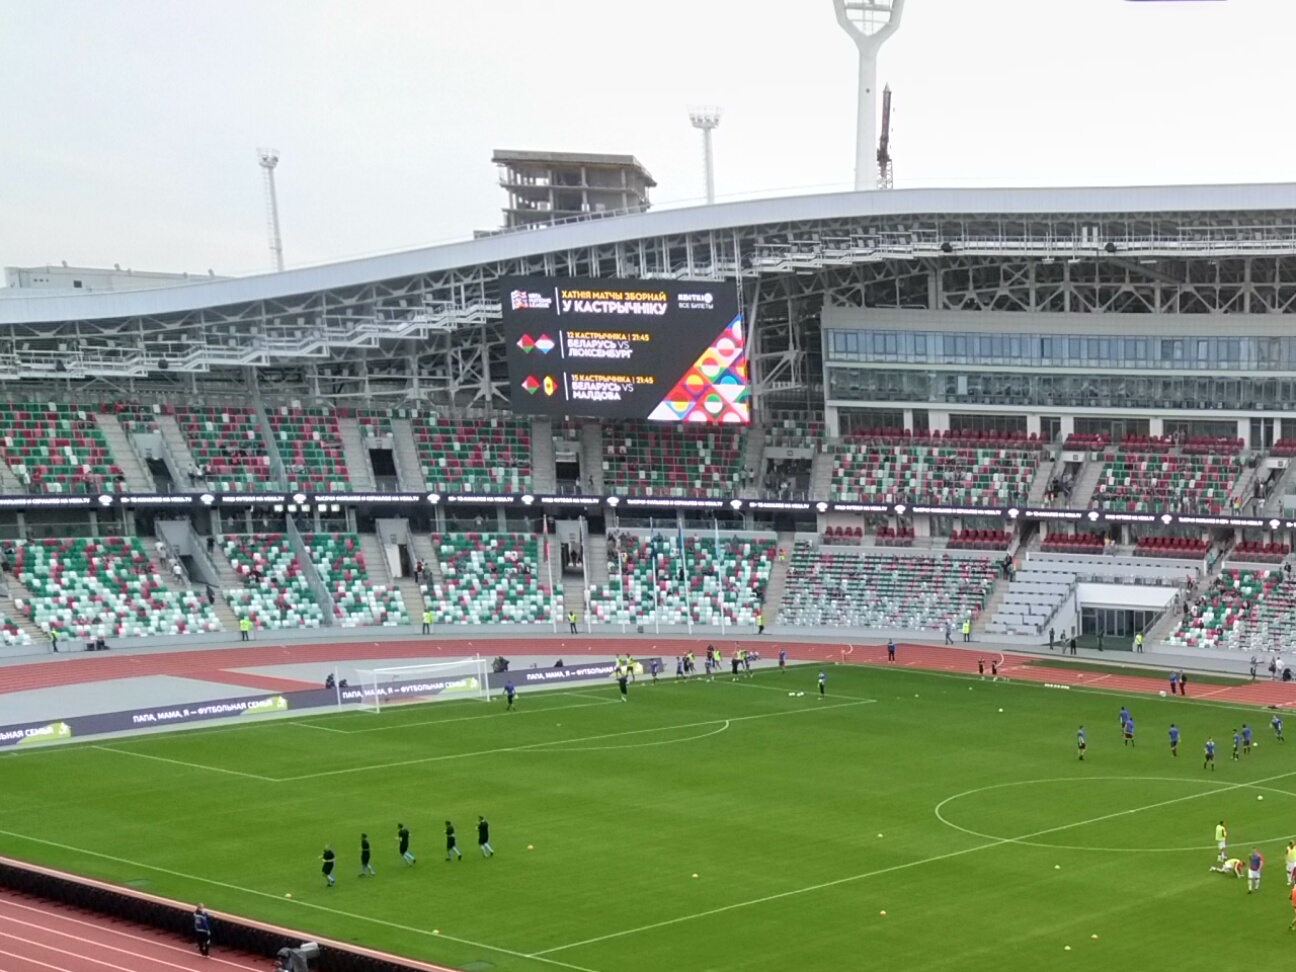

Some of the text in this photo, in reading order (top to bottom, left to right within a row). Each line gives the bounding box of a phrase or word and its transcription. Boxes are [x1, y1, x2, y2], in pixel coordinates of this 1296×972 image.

[561, 290, 666, 302] ХАТНІЯ МАТЧЫ ЗБОРНАЙ
[562, 300, 667, 315] У КАСТРЫЧНІКУ
[567, 331, 574, 339] 12
[632, 333, 650, 342] 21:45
[567, 339, 630, 350] БЕЛАРУСЬ VS
[636, 376, 654, 384] 21:45
[572, 381, 634, 392] БЕЛАРУСЬ VS
[573, 391, 621, 401] МАЛДОВА
[342, 691, 364, 699] ПАПА,
[387, 686, 393, 694] Я
[400, 681, 444, 693] ФУТБОЛЬНАЯ
[132, 714, 156, 723] ПАПА,
[157, 710, 183, 719] МАМА,
[183, 708, 190, 717] Я
[197, 702, 247, 714] ФУТБОЛЬНАЯ
[25, 726, 54, 737] СЕМЬЯ
